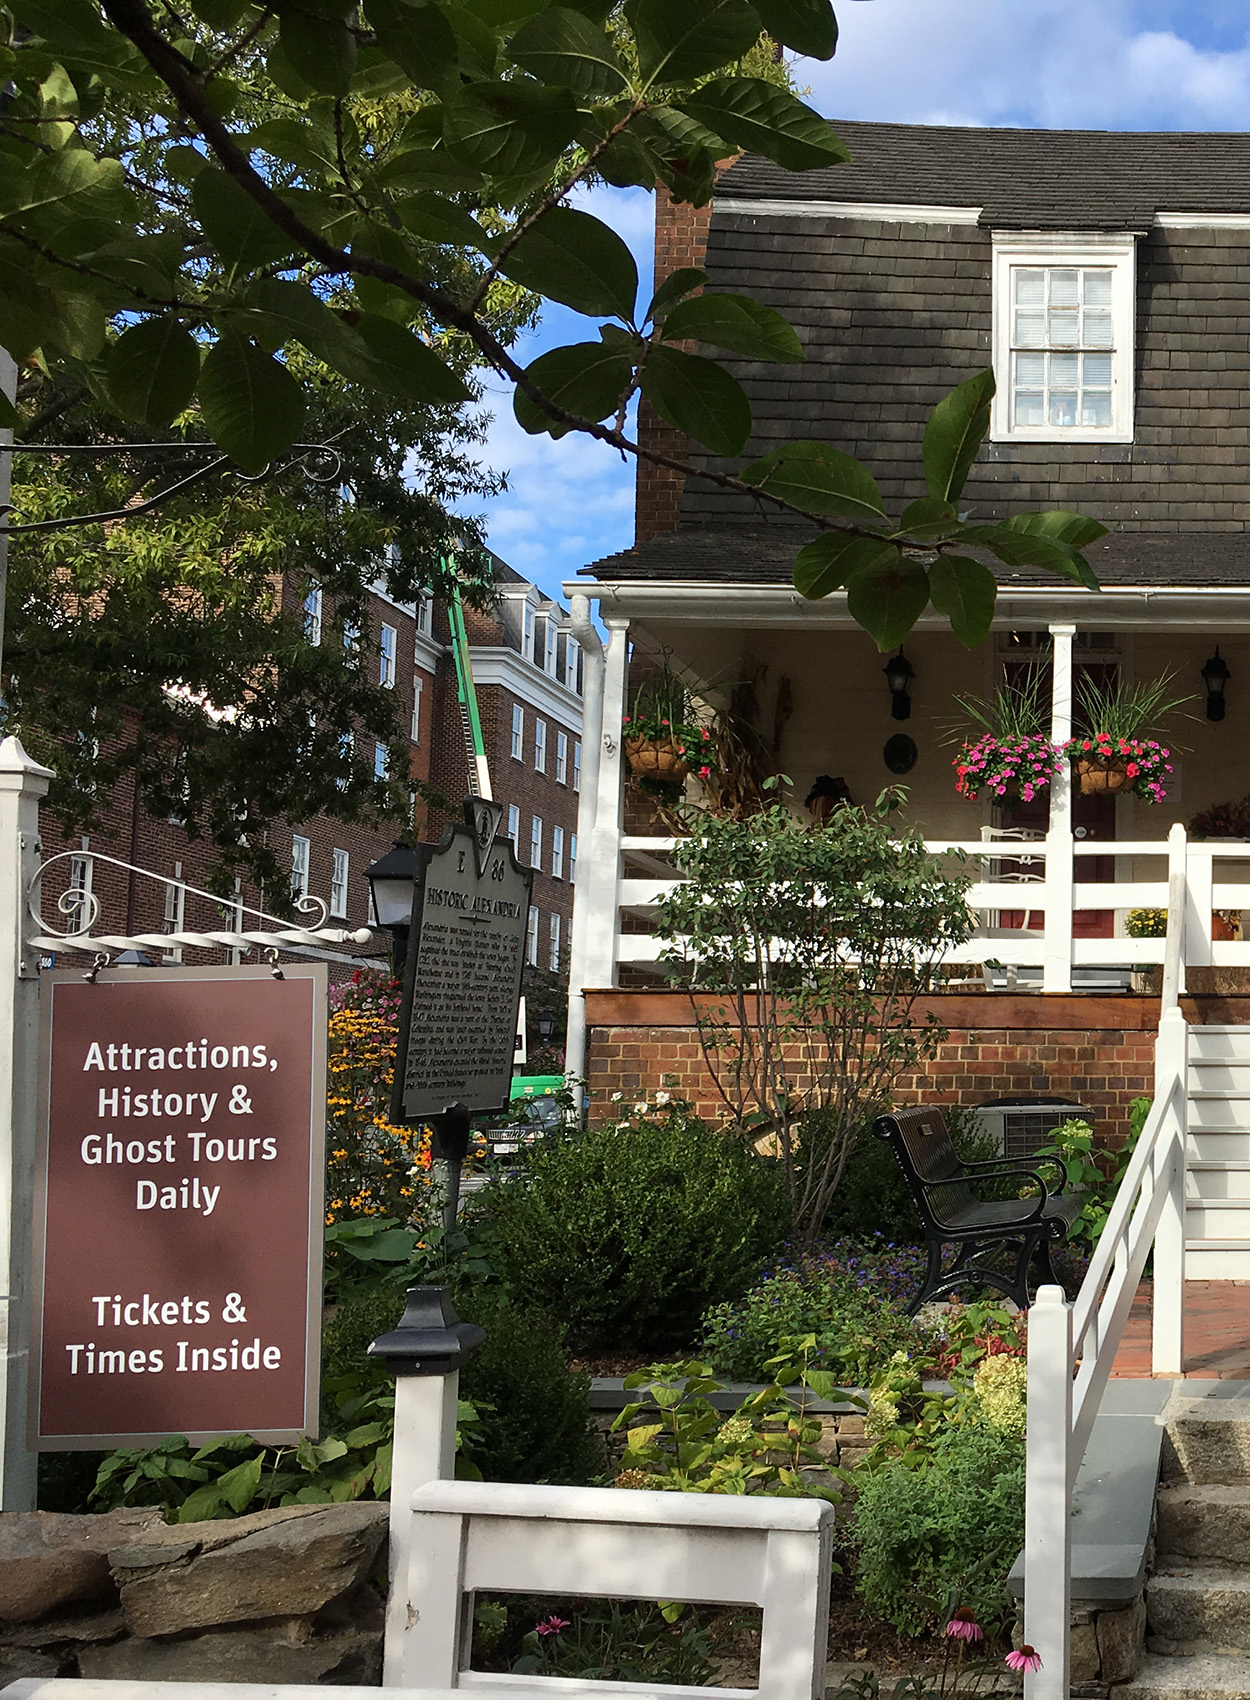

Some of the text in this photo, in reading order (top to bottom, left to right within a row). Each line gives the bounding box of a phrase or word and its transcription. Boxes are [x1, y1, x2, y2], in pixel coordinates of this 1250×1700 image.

[457, 851, 506, 882] E 86
[426, 887, 521, 920] HISTORIC ALEXANDRIA
[83, 1039, 277, 1071] Attractions,
[99, 1085, 253, 1122] History &
[82, 1133, 277, 1164] Ghost Tours
[137, 1178, 220, 1215] Daily
[92, 1293, 247, 1326] Tickets &
[66, 1338, 280, 1374] Times Inside
